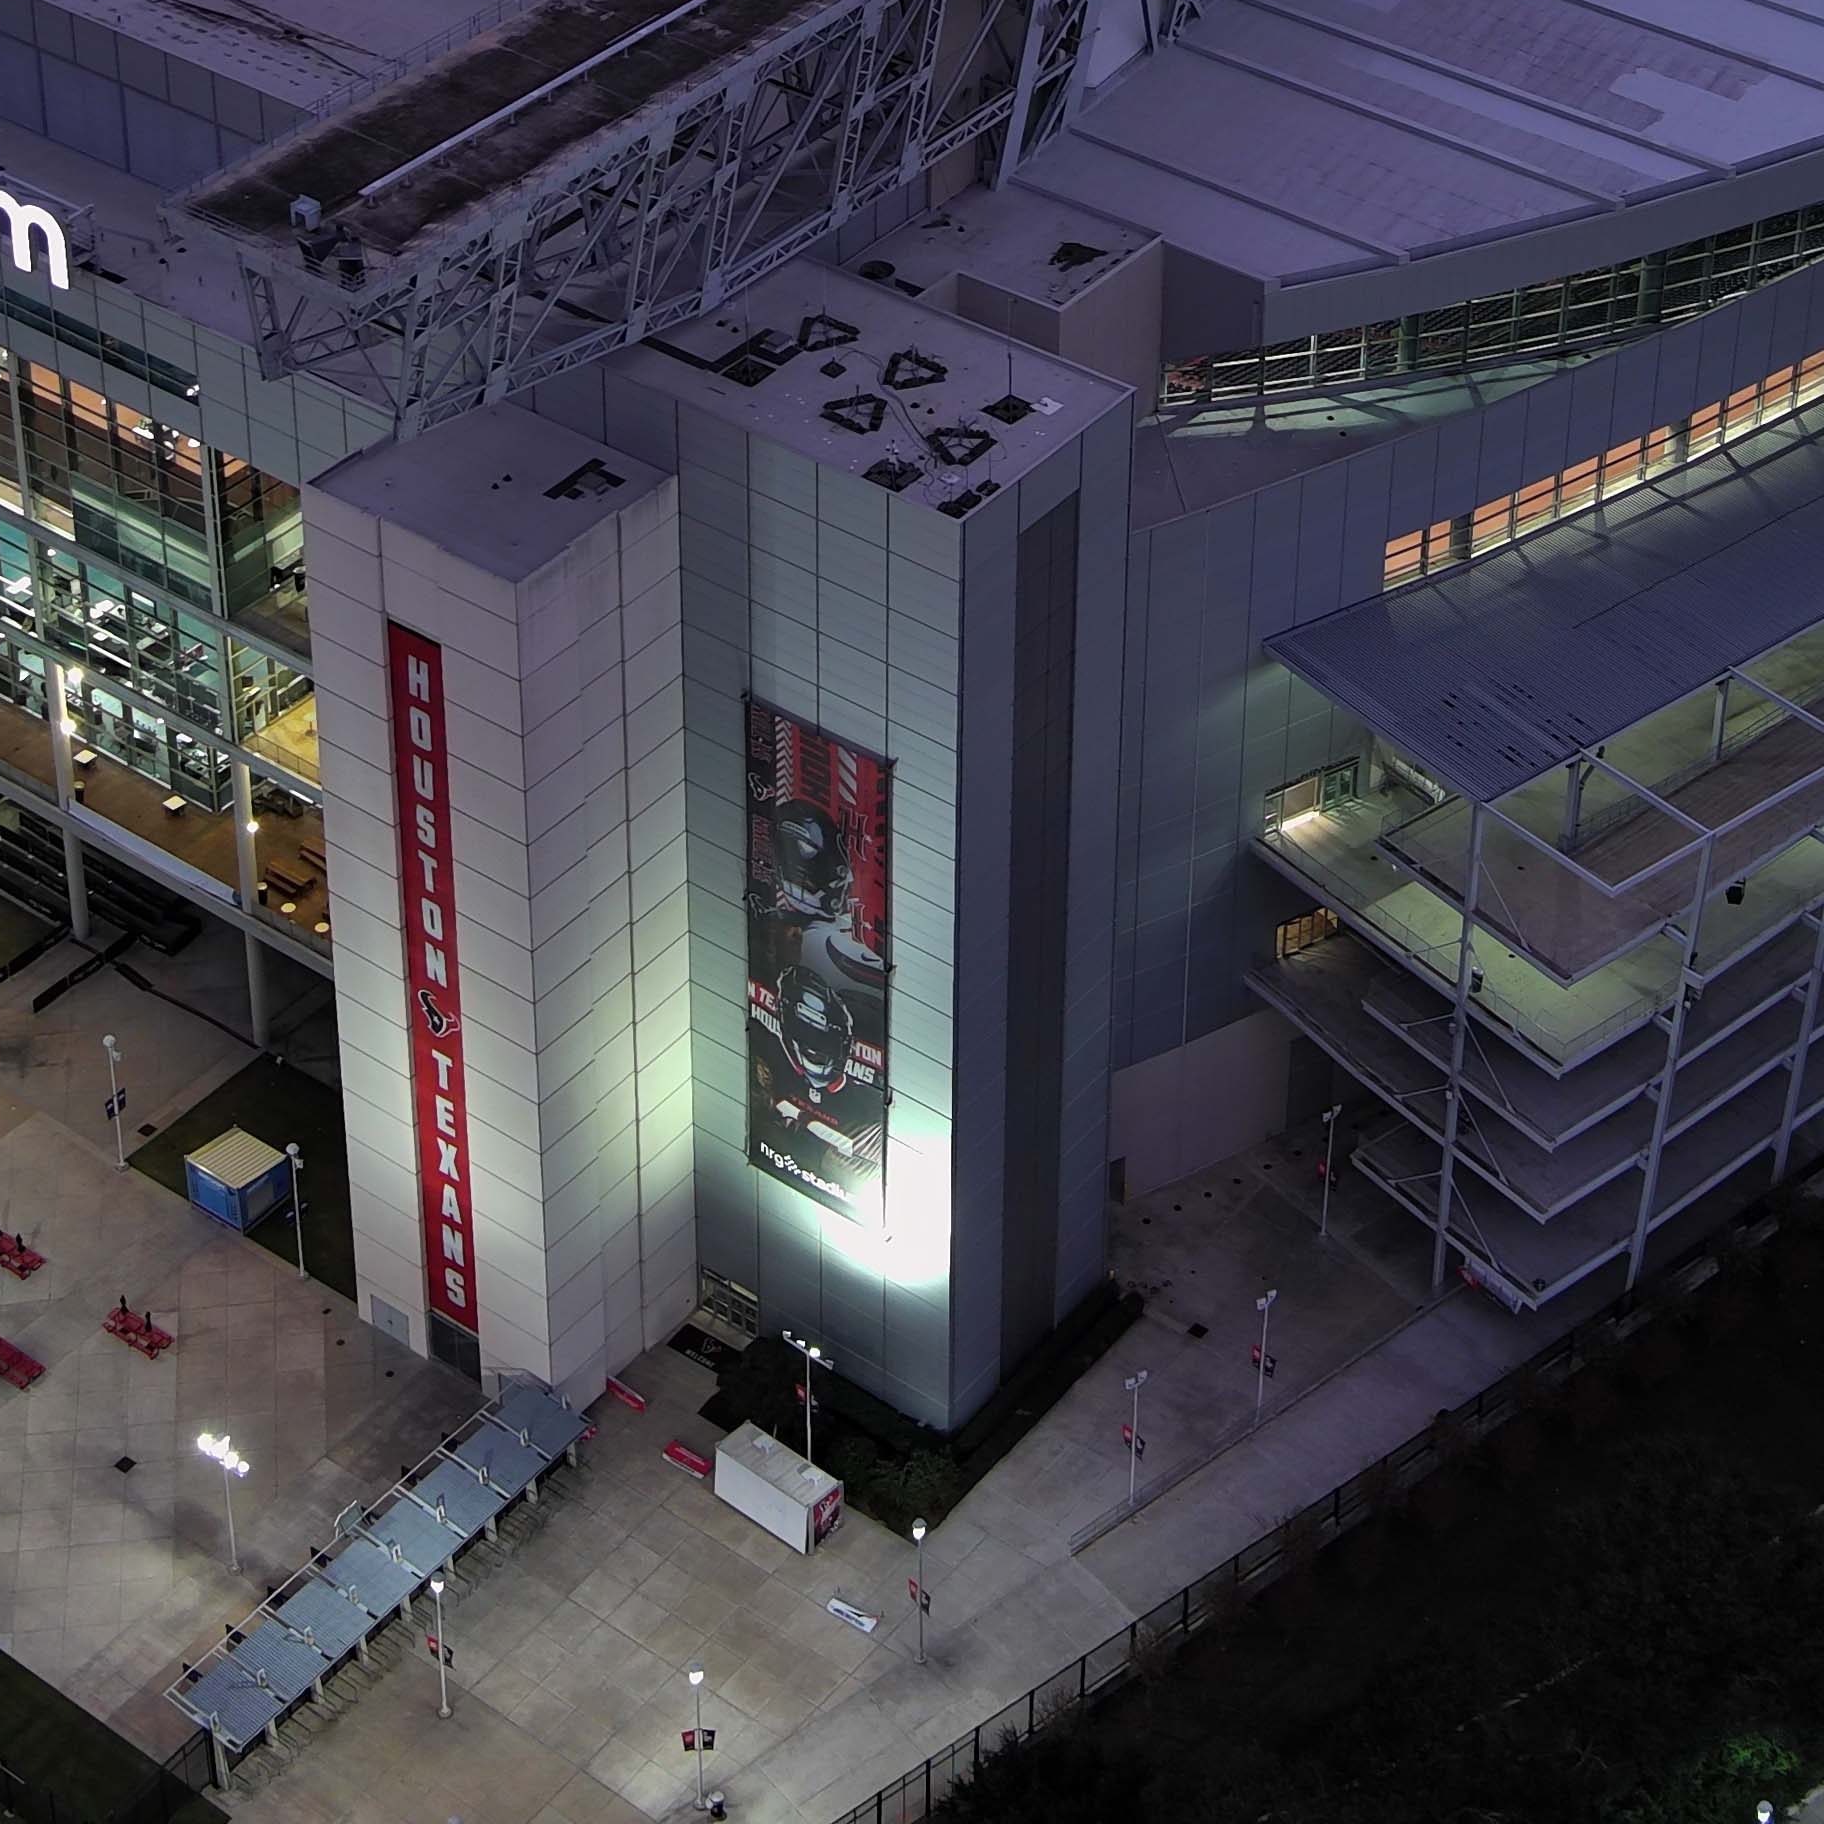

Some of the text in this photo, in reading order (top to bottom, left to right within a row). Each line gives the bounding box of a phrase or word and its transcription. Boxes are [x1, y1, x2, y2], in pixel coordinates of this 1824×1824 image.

[407, 653, 467, 1309] HOUSTON TEXANS
[760, 1140, 784, 1168] nrg
